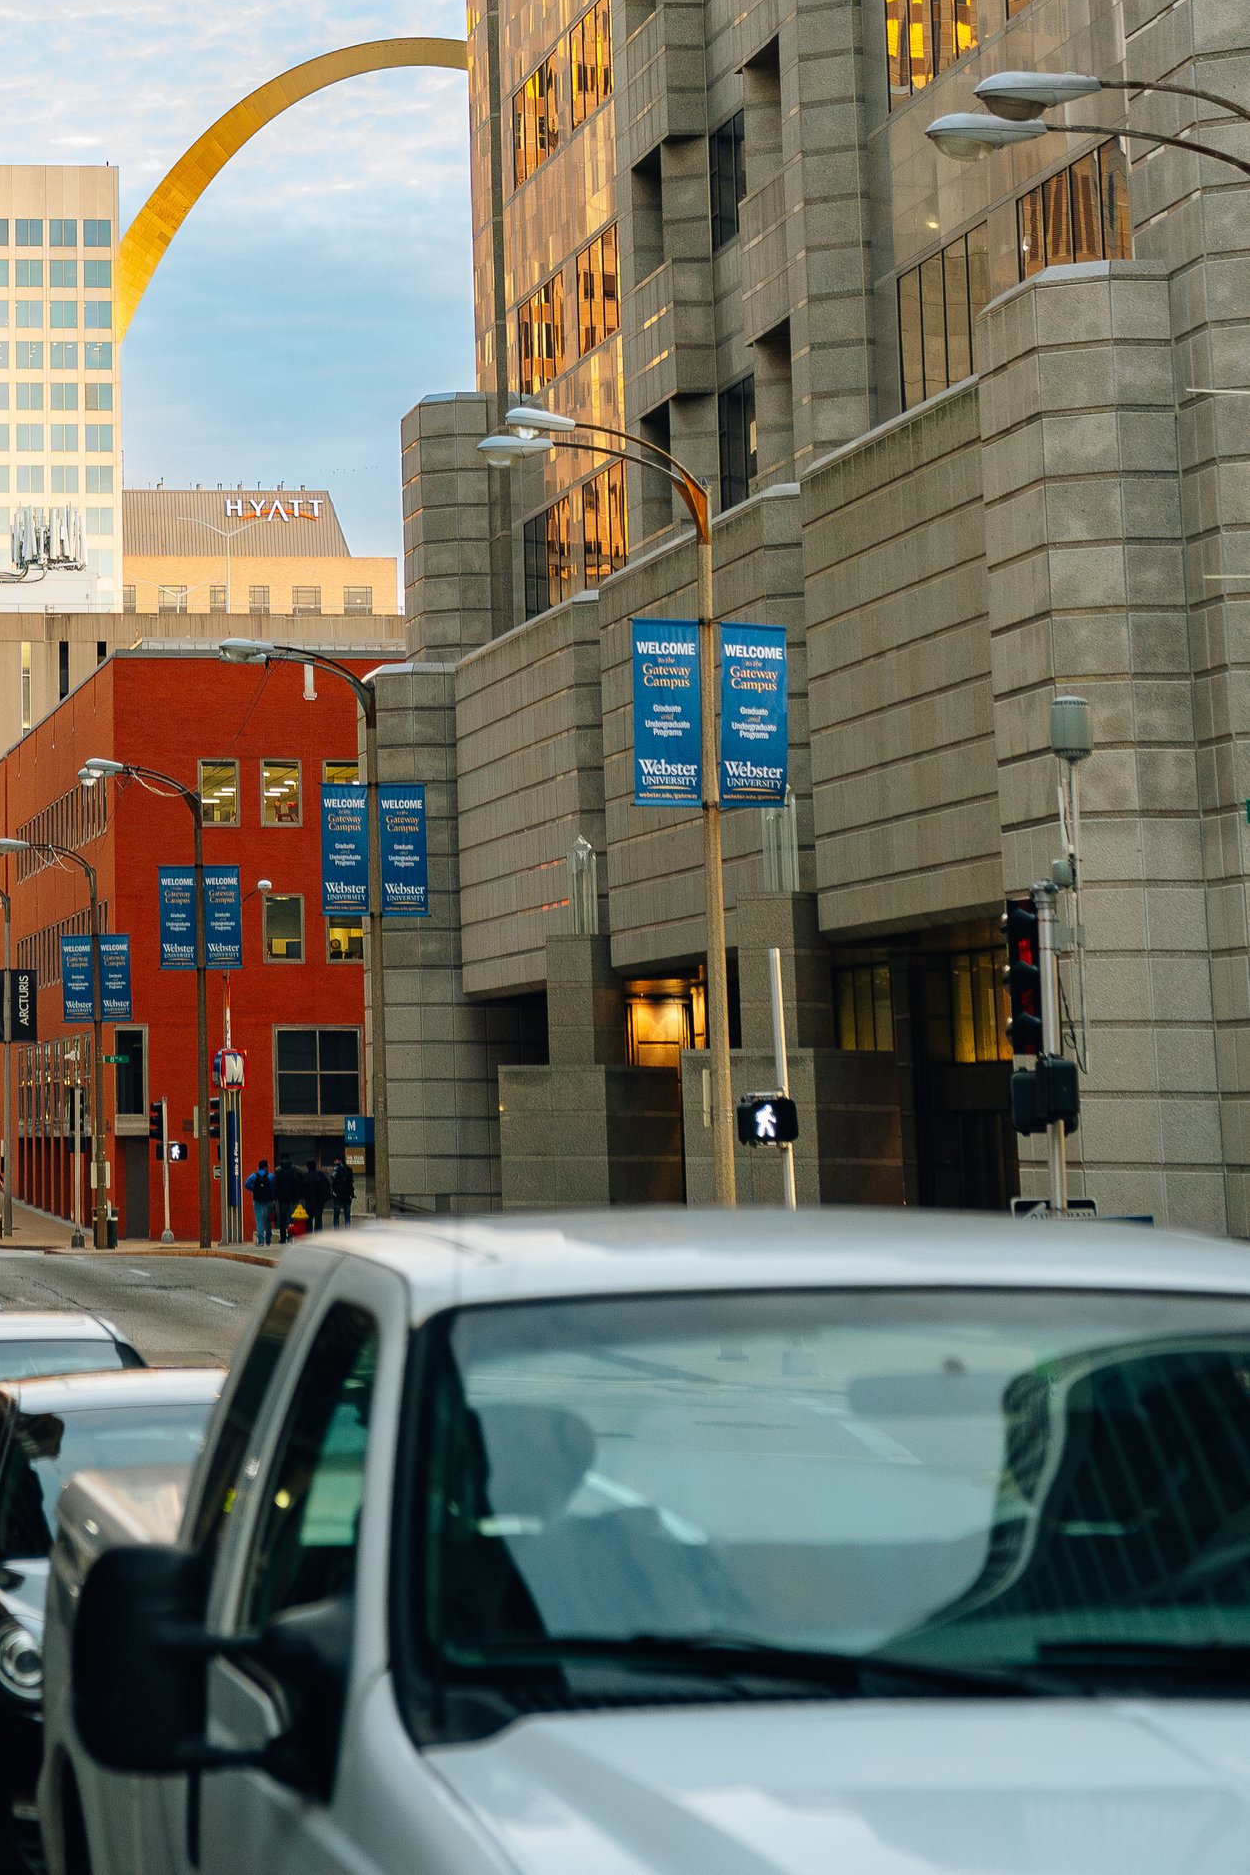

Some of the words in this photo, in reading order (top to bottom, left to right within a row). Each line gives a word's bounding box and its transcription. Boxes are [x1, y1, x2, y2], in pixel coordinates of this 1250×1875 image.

[226, 499, 323, 522] HYATT
[637, 641, 695, 655] WELCOME
[724, 644, 783, 659] WELCOME
[642, 663, 690, 678] Gateway
[730, 666, 778, 682] Gateway
[643, 676, 690, 689] Campus
[731, 679, 777, 693] Campus
[653, 704, 681, 712] Graduate
[740, 707, 768, 715] Graduate
[645, 720, 690, 729] Undergraduate
[731, 722, 777, 732] Undergraduate
[653, 729, 682, 737] Programs
[740, 731, 769, 739] Programs
[638, 759, 698, 775] Webster
[724, 761, 783, 779] Webster
[642, 776, 697, 786] UNIVERSITY
[727, 778, 782, 789] UNIVERSITY
[324, 798, 365, 808] WELCOME
[381, 800, 422, 809] WELCOME
[328, 814, 362, 823] Gateway
[386, 815, 419, 825] Gateway
[328, 822, 361, 833] Campus
[386, 823, 419, 833] Campus
[161, 878, 194, 886] WELCOME
[205, 877, 238, 885] WELCOME
[325, 881, 366, 893] Webster
[385, 883, 425, 895] Webster
[164, 890, 191, 898] Gateway
[209, 890, 236, 898] Gateway
[165, 897, 190, 905] Campus
[210, 896, 235, 905] Campus
[63, 945, 90, 953] WELCOME
[100, 944, 128, 952] WELCOME
[163, 943, 194, 953] Webster
[207, 943, 240, 953] Webster
[19, 975, 29, 1026] ARCTURIS
[65, 1000, 93, 1009] Webster
[103, 999, 130, 1007] Webster
[347, 1120, 356, 1131] M
